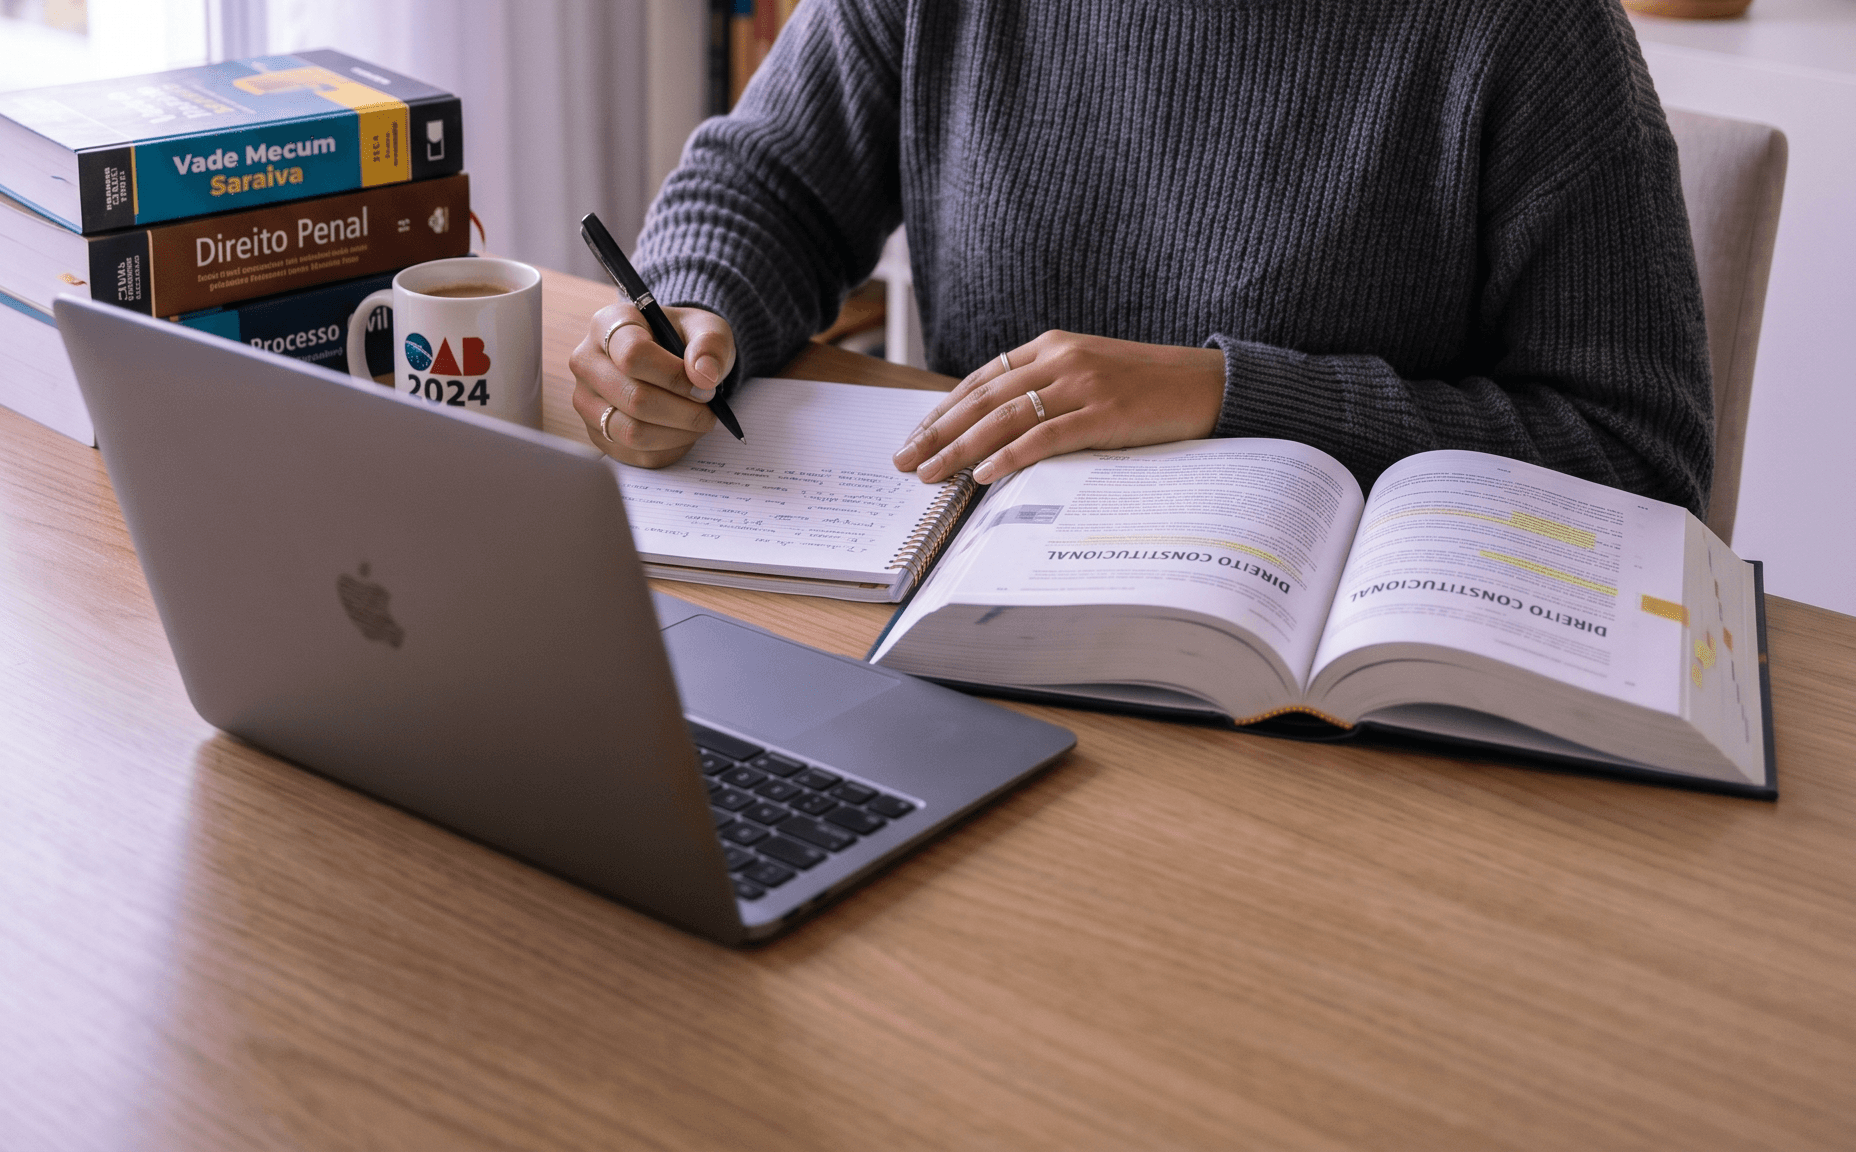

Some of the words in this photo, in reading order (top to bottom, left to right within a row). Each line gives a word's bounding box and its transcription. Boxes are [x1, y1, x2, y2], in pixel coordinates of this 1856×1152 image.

[172, 148, 239, 176] Vade
[245, 135, 337, 166] Mecum
[210, 164, 304, 197] Saraiva
[196, 226, 288, 268] Direito
[297, 205, 369, 249] Penal
[404, 332, 492, 377] OAB
[407, 373, 491, 407] 2024
[1047, 550, 1213, 563] CONSTITUCIONAL
[1217, 555, 1292, 595] DIREITO
[1349, 579, 1524, 611] CONSTITUCIONAL
[1528, 604, 1609, 638] DIREITO
